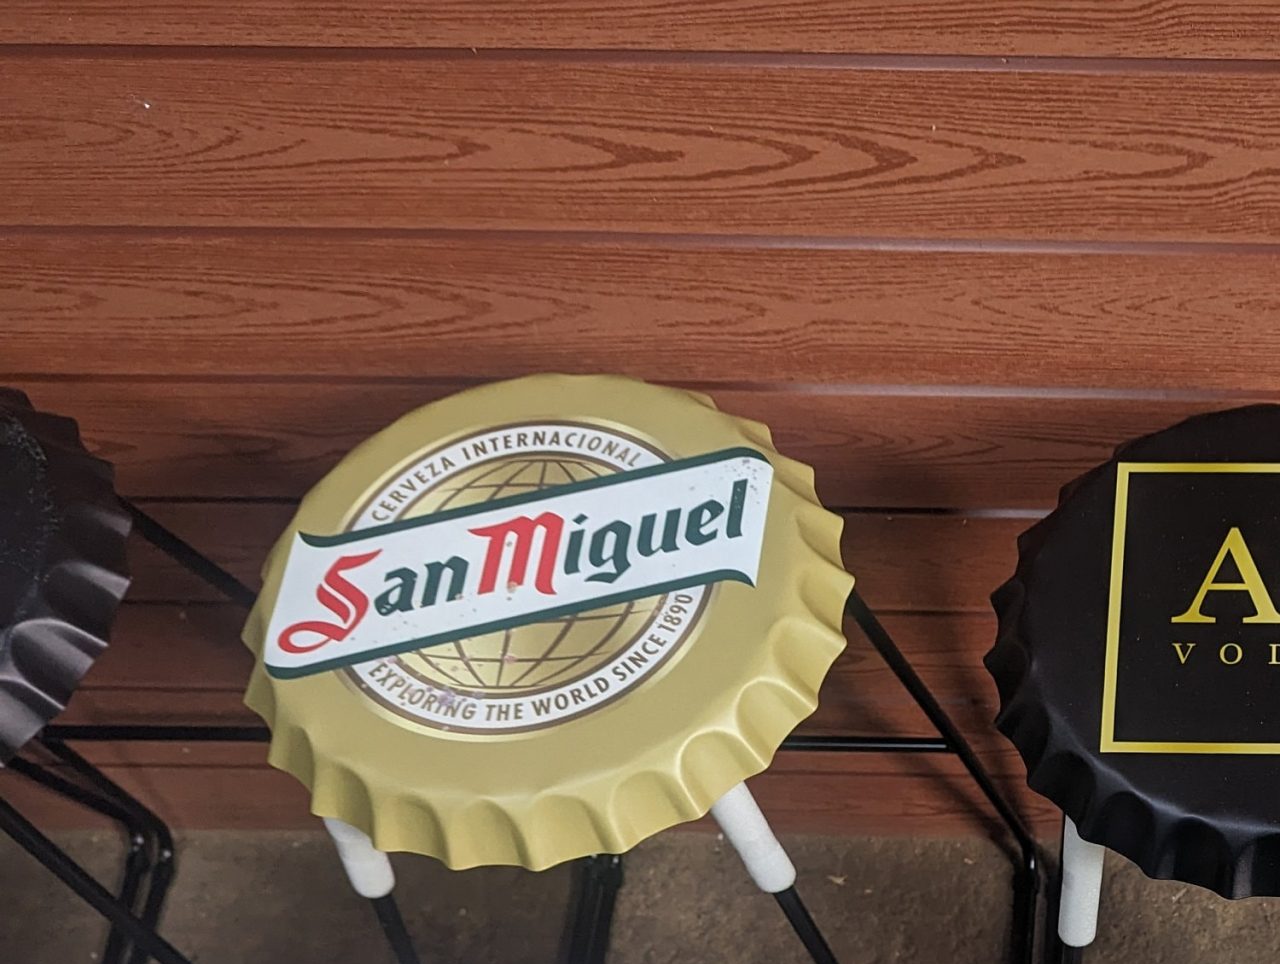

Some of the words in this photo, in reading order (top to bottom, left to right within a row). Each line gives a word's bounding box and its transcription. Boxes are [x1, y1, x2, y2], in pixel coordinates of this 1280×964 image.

[371, 455, 456, 523] CERVEZA
[461, 430, 643, 469] INTERNACIONAL
[367, 662, 477, 721] EXPLORING
[485, 703, 523, 722] THE
[530, 676, 610, 717] WORLD
[611, 632, 667, 682] SINCE
[657, 592, 693, 633] 1890
